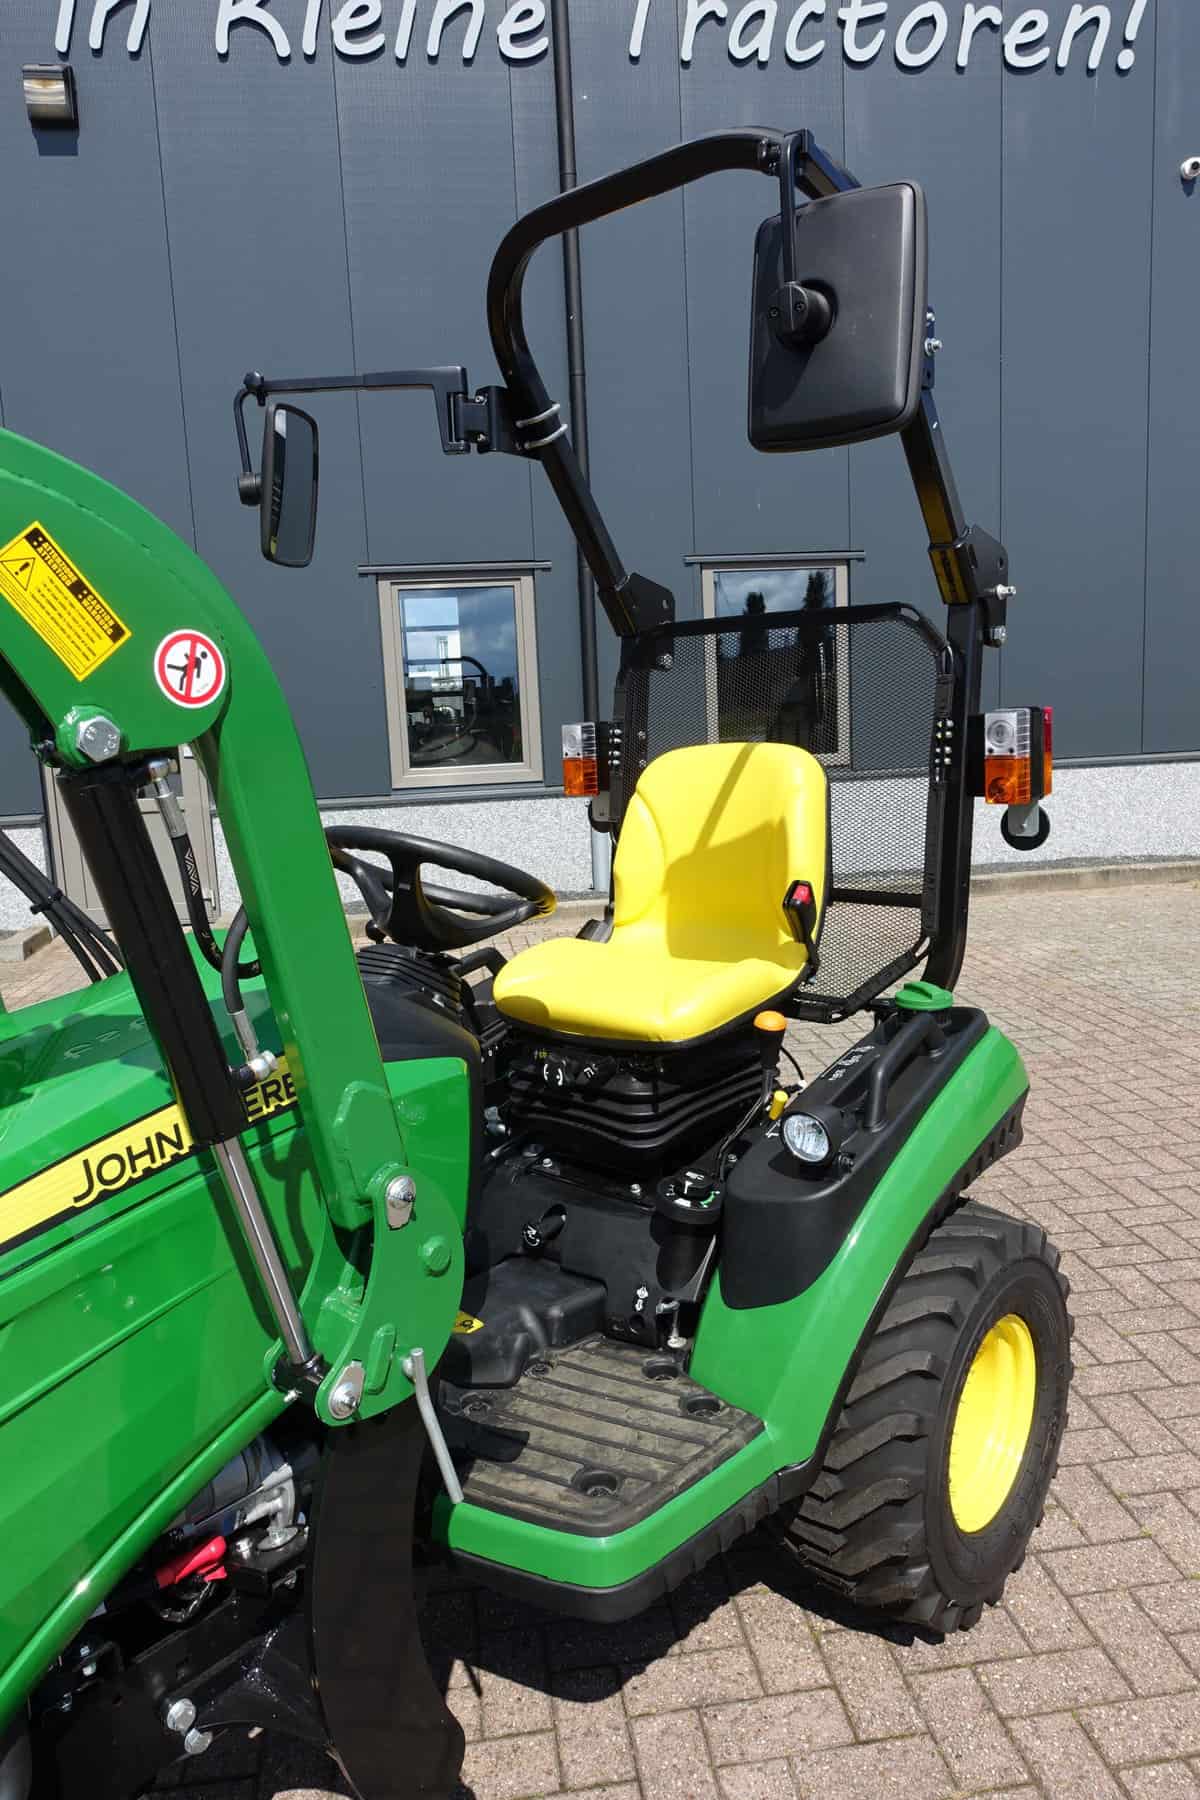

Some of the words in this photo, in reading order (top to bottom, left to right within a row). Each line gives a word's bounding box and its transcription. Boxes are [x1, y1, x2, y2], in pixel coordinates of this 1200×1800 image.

[215, 0, 549, 60] Kleine
[86, 594, 115, 627] CAUTION
[73, 1123, 185, 1203] JOHN
[241, 1071, 297, 1118] ERE
